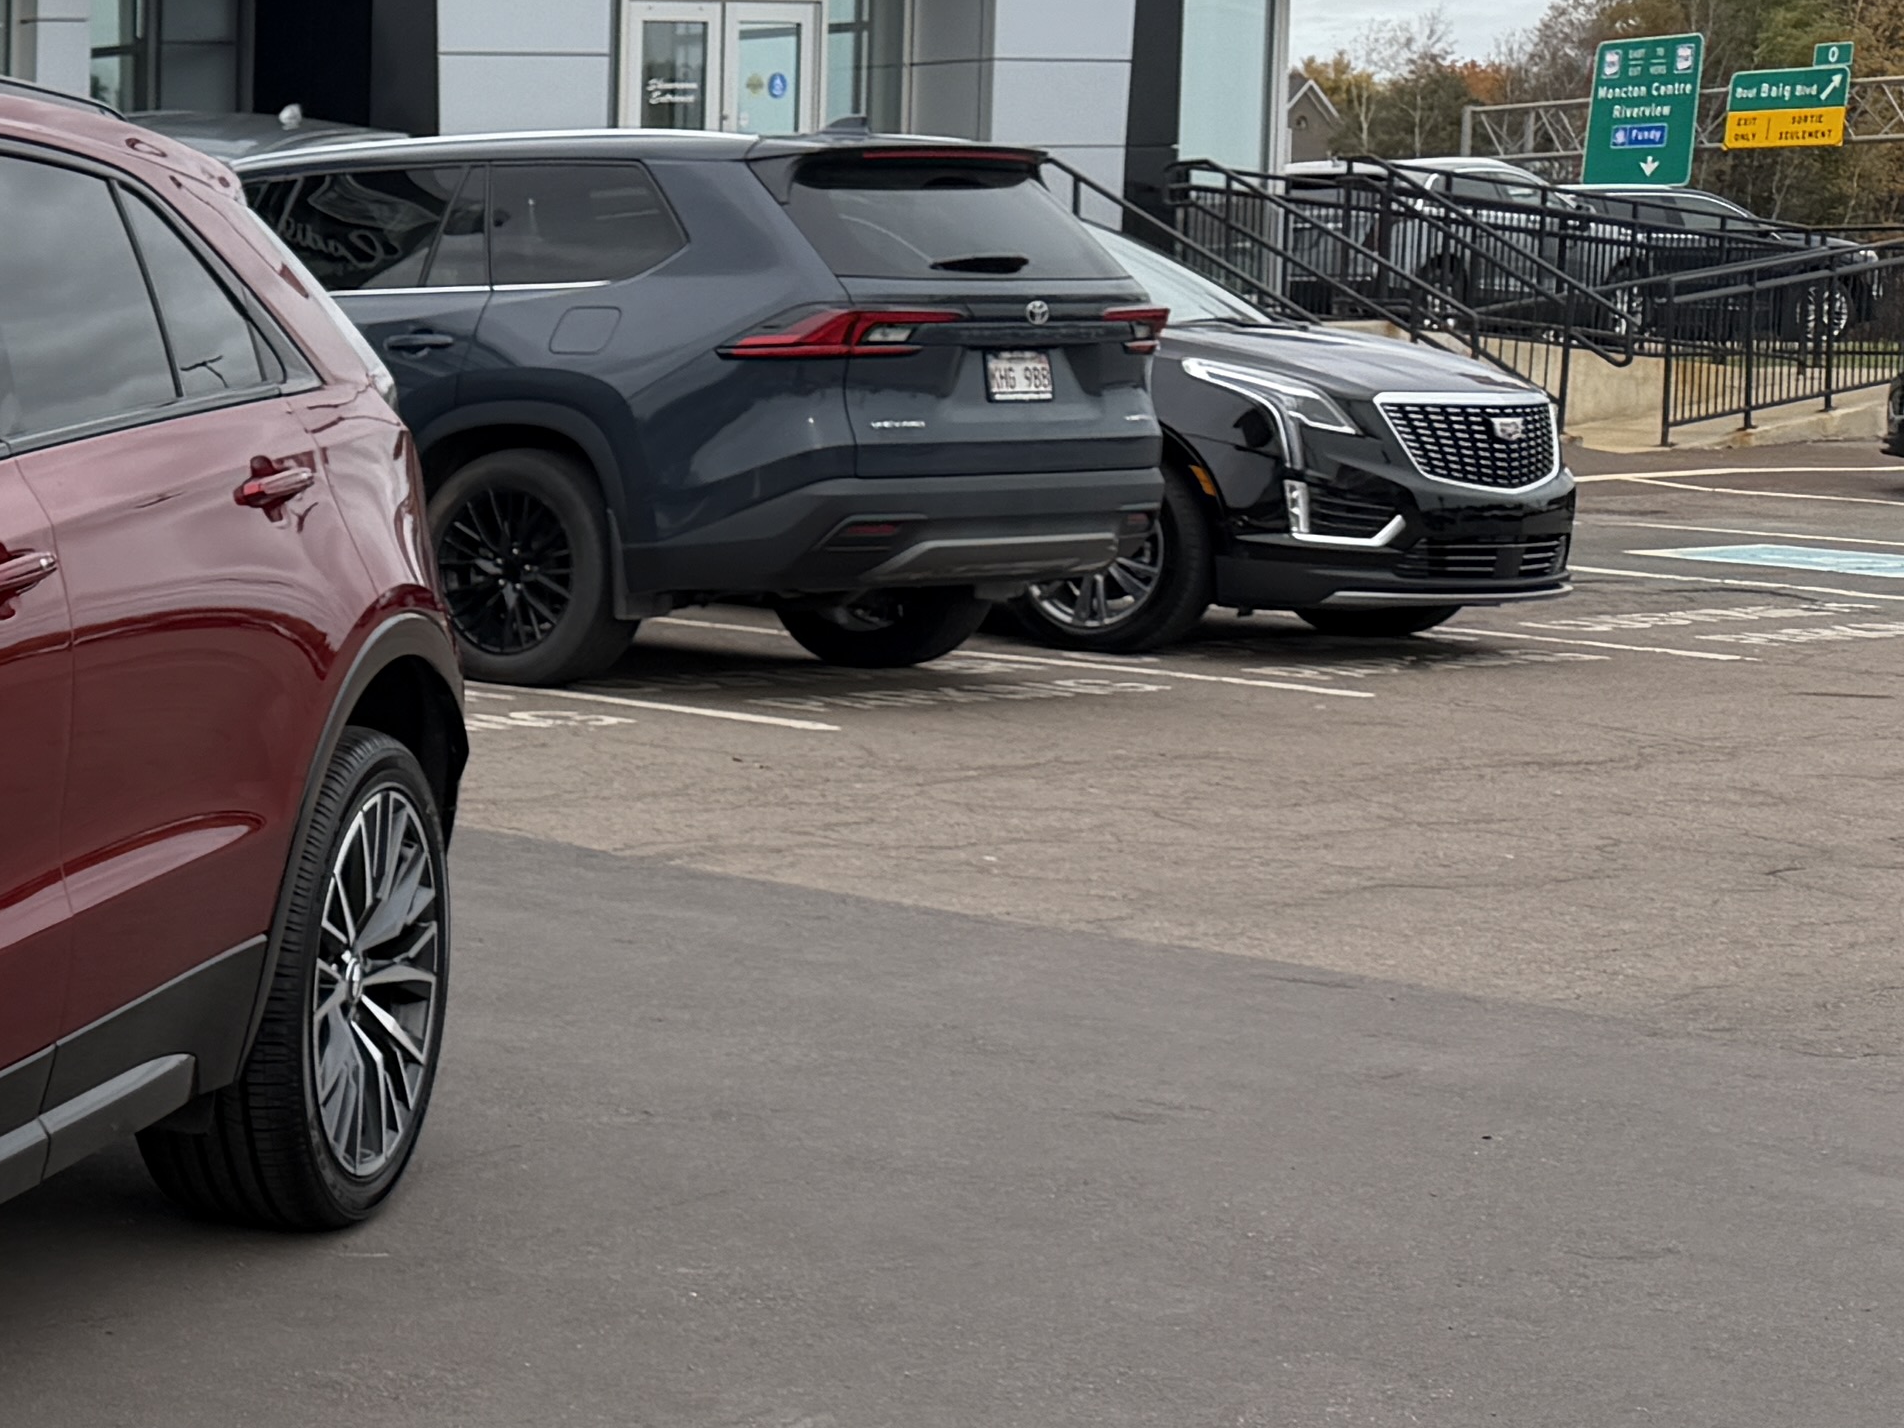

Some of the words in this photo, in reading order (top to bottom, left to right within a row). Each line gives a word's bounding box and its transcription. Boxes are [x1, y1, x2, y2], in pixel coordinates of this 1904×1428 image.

[1597, 86, 1647, 99] Moncton
[1652, 82, 1693, 95] Centre
[1612, 103, 1671, 118] Riverview
[1736, 117, 1757, 126] EXIT
[1791, 114, 1824, 124] SORTIE
[1631, 129, 1662, 142] Fundy
[1734, 133, 1757, 141] ONLY
[1778, 129, 1833, 140] SEULEMENT
